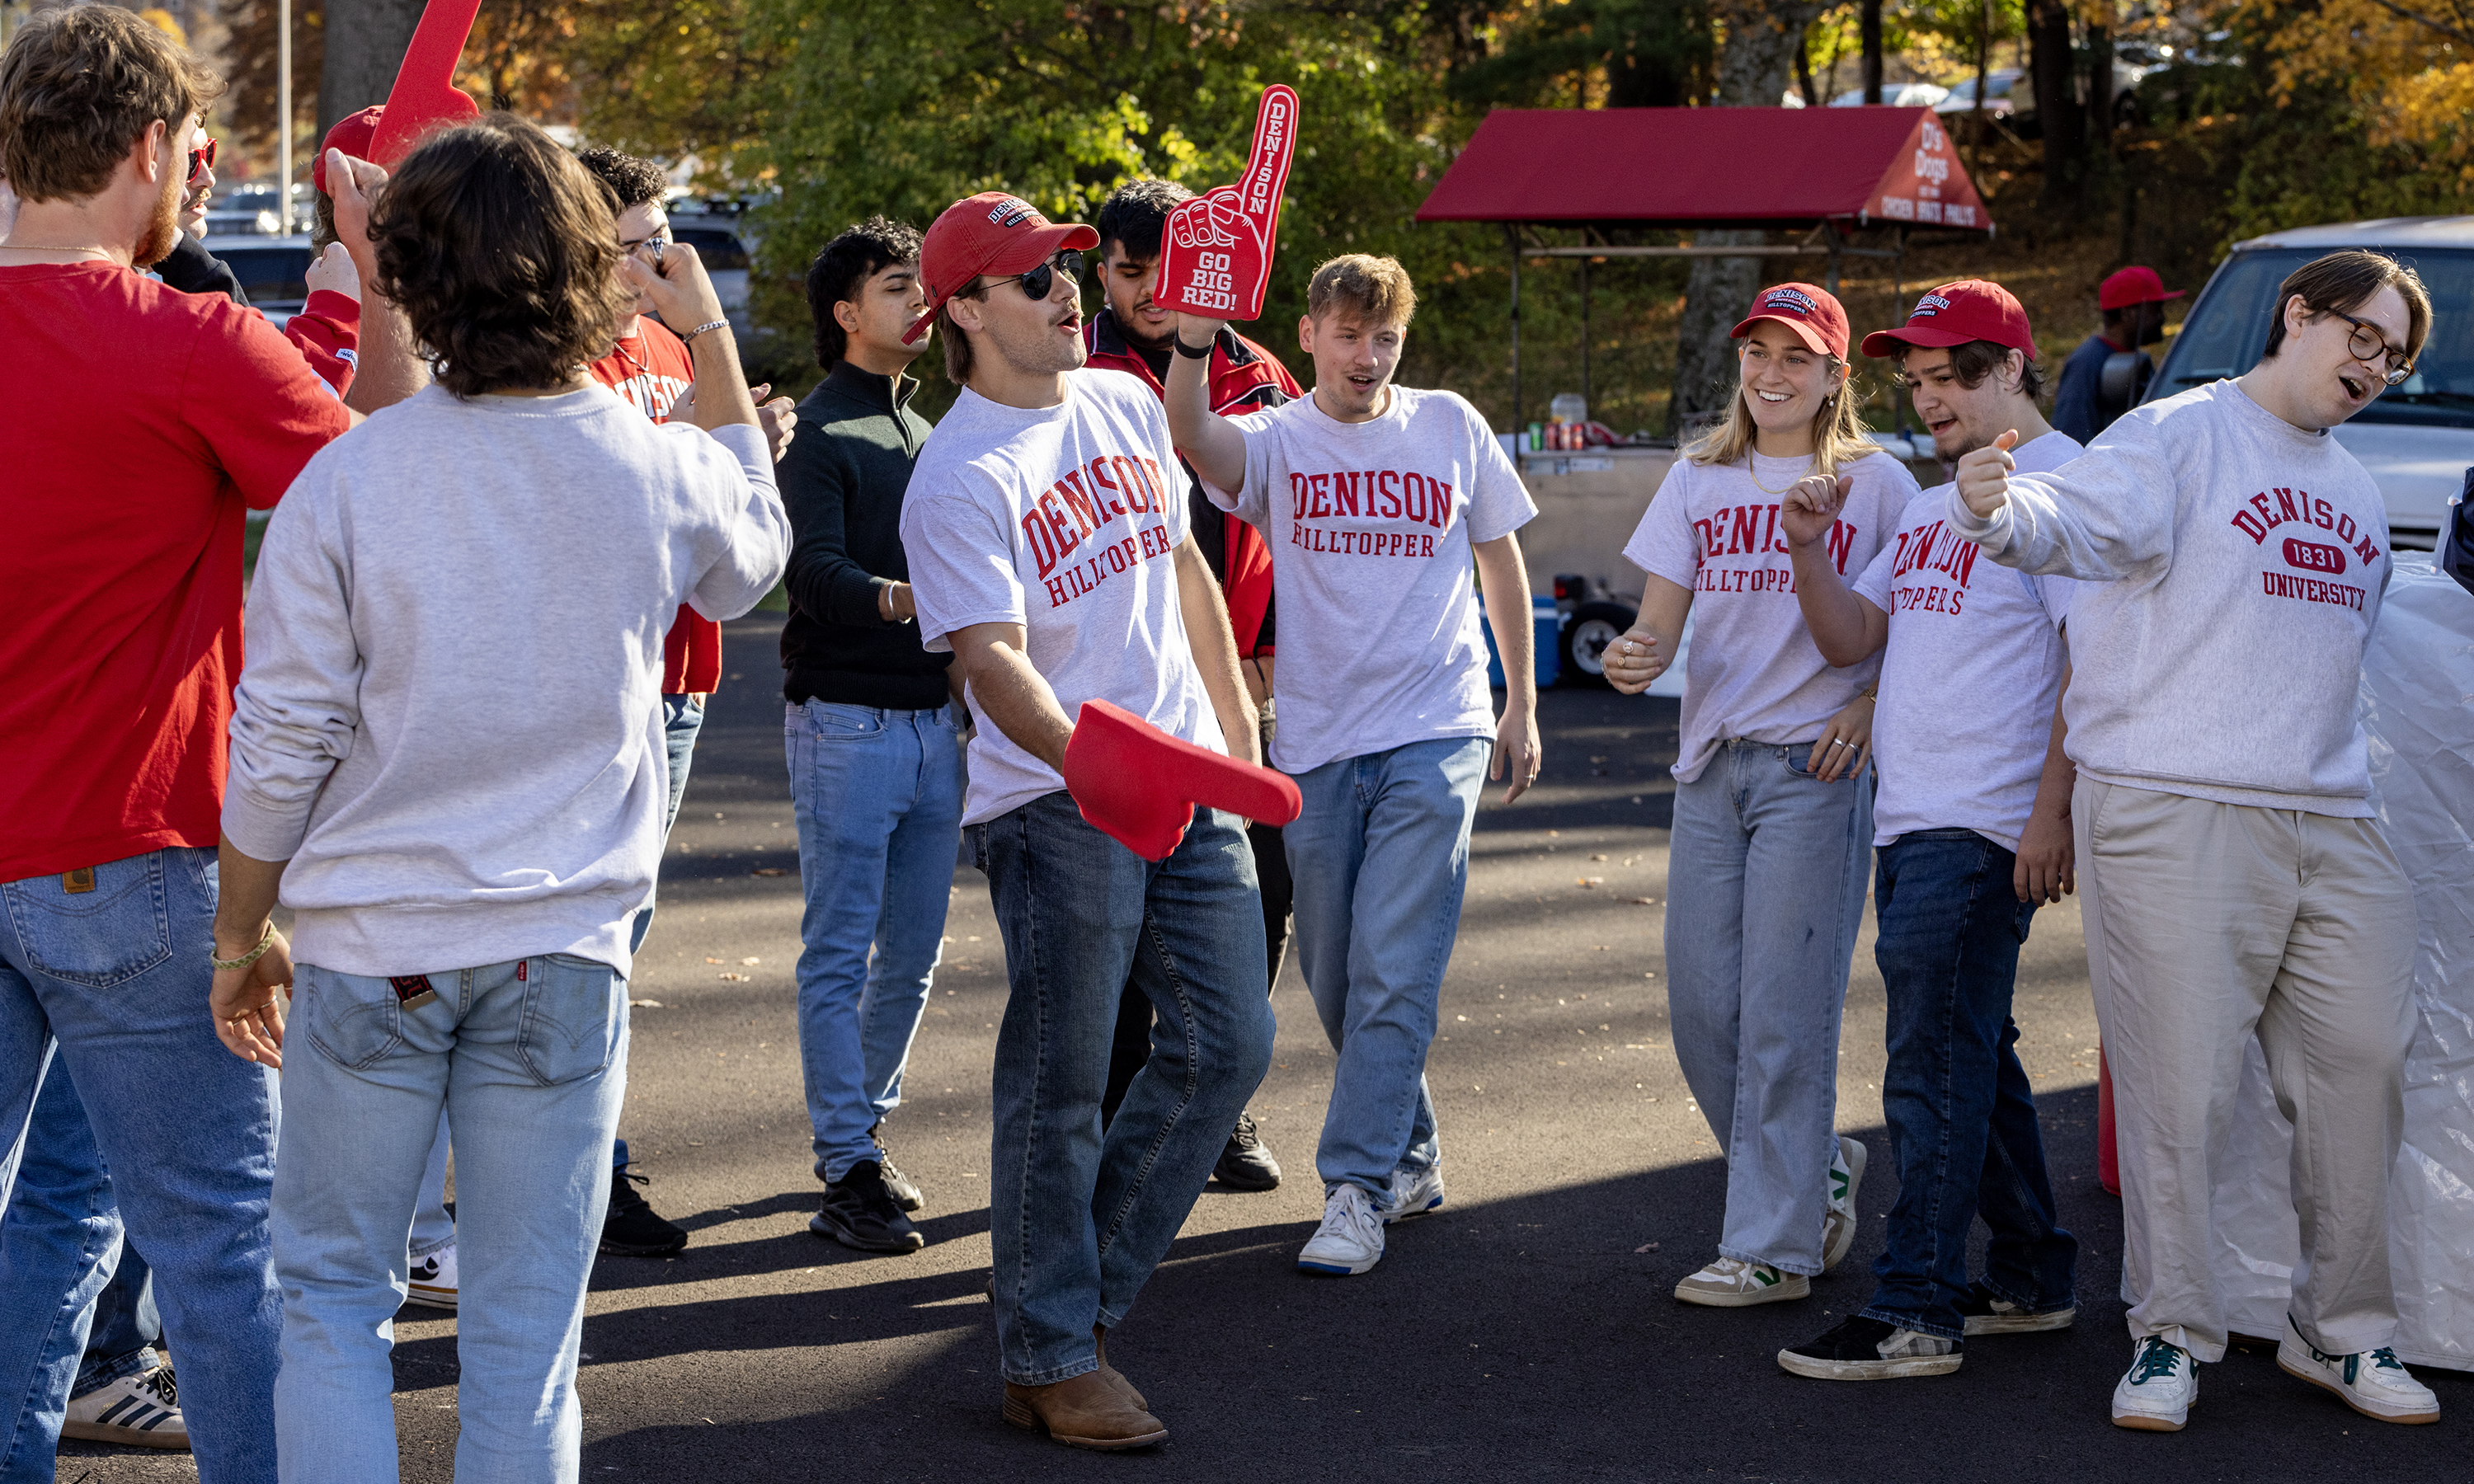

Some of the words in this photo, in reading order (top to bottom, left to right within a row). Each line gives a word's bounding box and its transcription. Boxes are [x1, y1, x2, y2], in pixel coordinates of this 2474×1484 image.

[1249, 103, 1286, 214] DENISON
[1914, 148, 1949, 186] Dogs
[1191, 269, 1232, 291] BIG
[1198, 251, 1230, 272] GO
[1181, 286, 1237, 311] RED!
[1765, 289, 1817, 312] DENISON
[1767, 302, 1806, 314] HILLTOPPERS
[1775, 298, 1802, 306] UNIVERSITY
[1021, 455, 1168, 582] DENISON
[1290, 470, 1452, 533] DENISON
[1291, 521, 1435, 558] HILLTOPPER
[1692, 504, 1857, 576] DENIN
[2231, 487, 2381, 567] DENISON
[2293, 542, 2336, 569] 1831
[2262, 571, 2366, 612] UNIVERSITY
